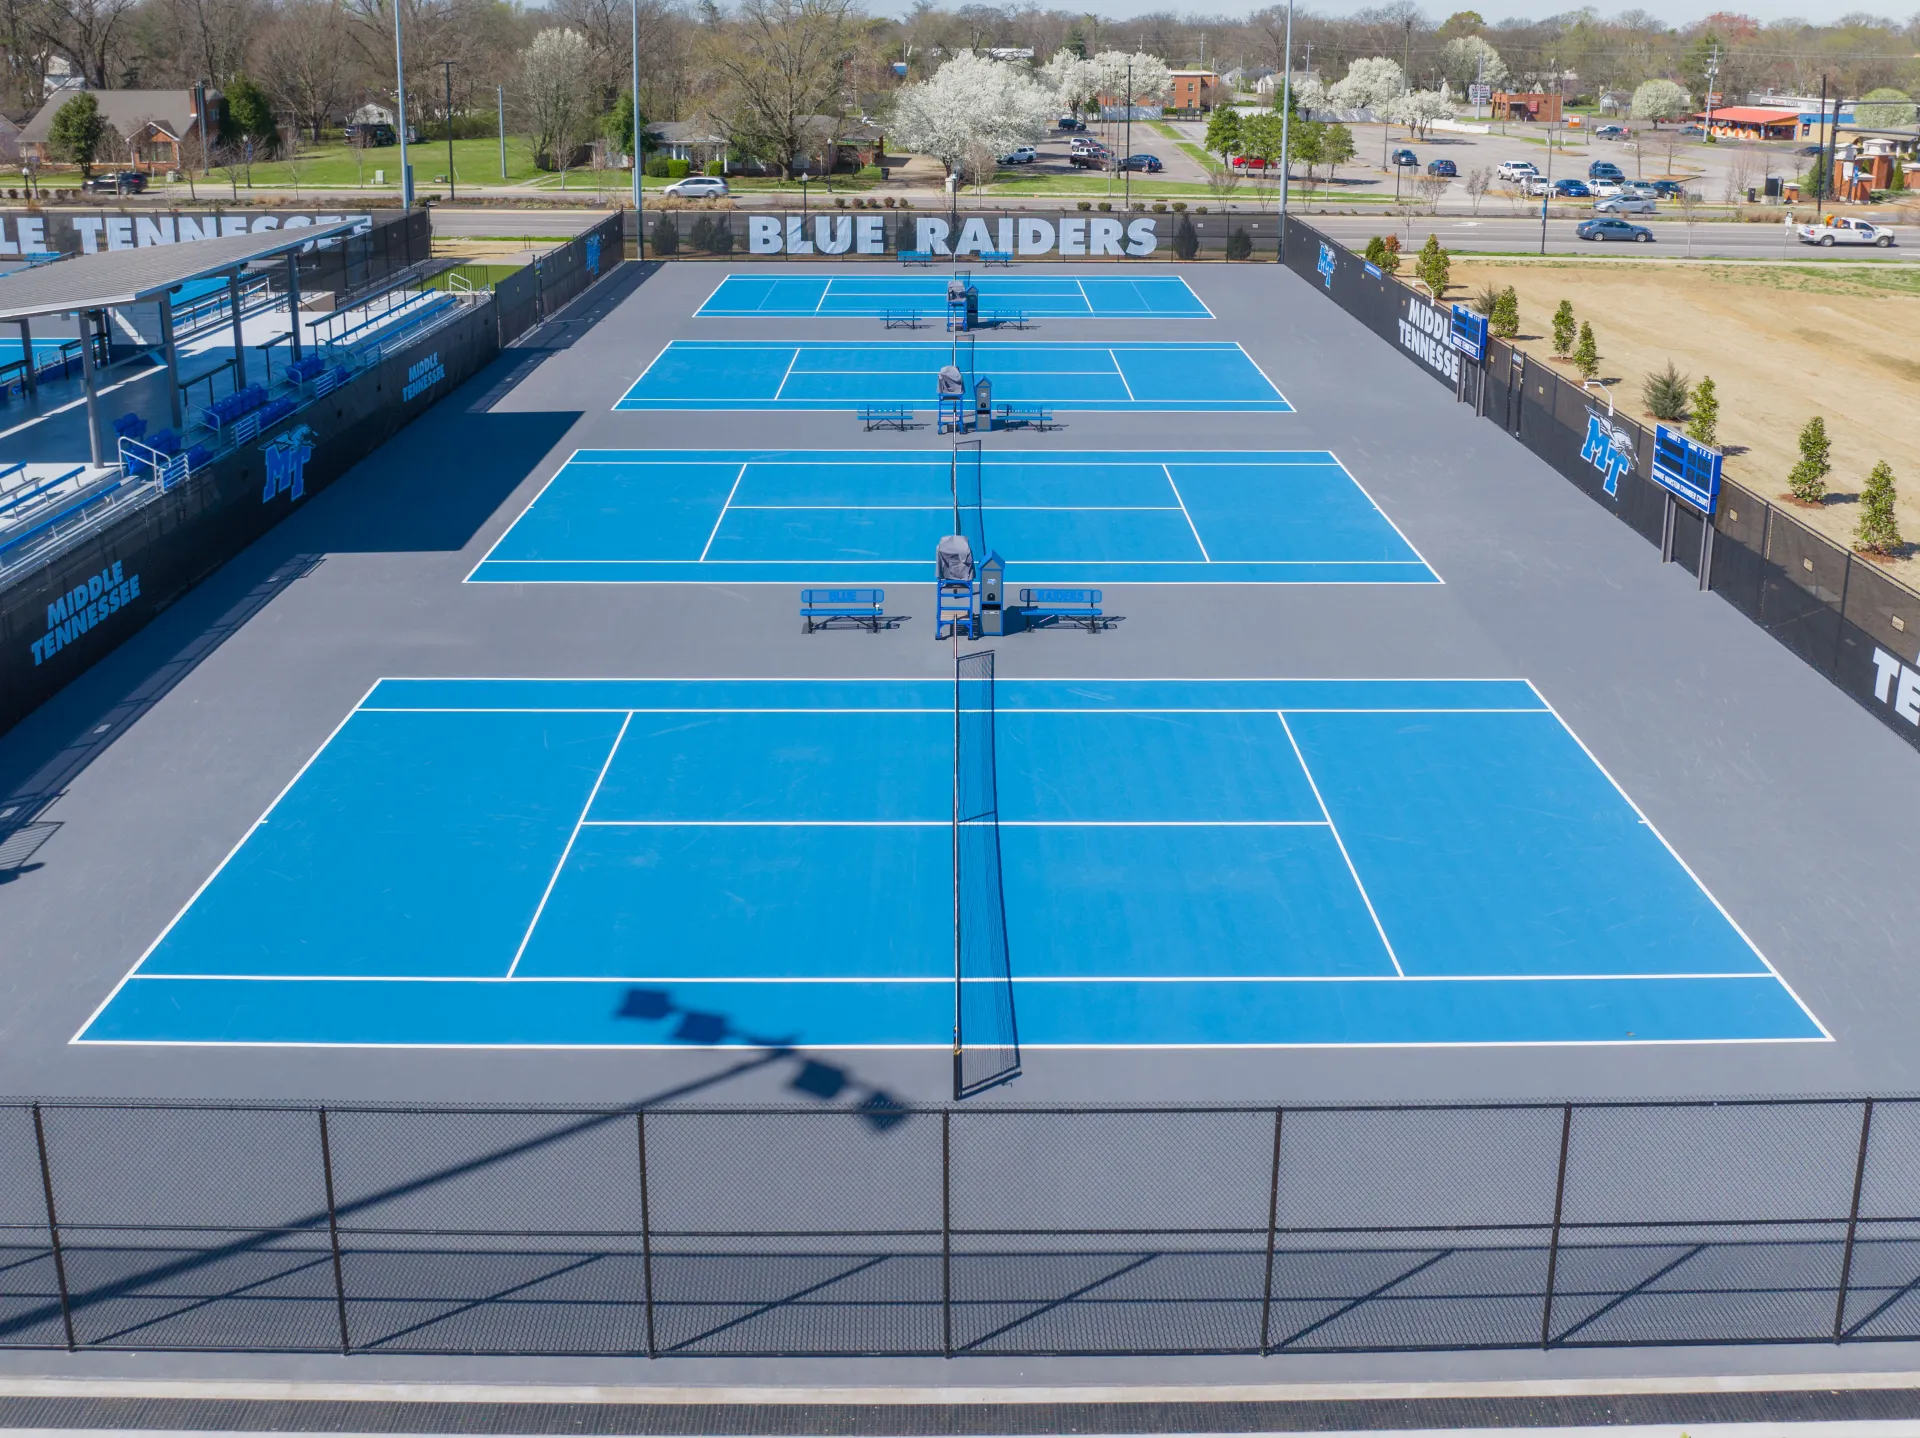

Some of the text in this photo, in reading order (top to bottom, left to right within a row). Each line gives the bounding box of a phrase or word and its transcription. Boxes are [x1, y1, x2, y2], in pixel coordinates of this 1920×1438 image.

[0, 217, 47, 254] LE
[749, 216, 1157, 255] BLUE RAIDERS
[1399, 318, 1459, 383] TENNESSE
[1408, 298, 1456, 351] MIDDL
[402, 364, 446, 403] TENNESSEE
[409, 352, 438, 383] MIDDLE
[263, 444, 311, 504] MT
[1580, 415, 1630, 497] MT
[31, 573, 141, 667] TENNESSEE
[47, 560, 123, 630] MIDDLE
